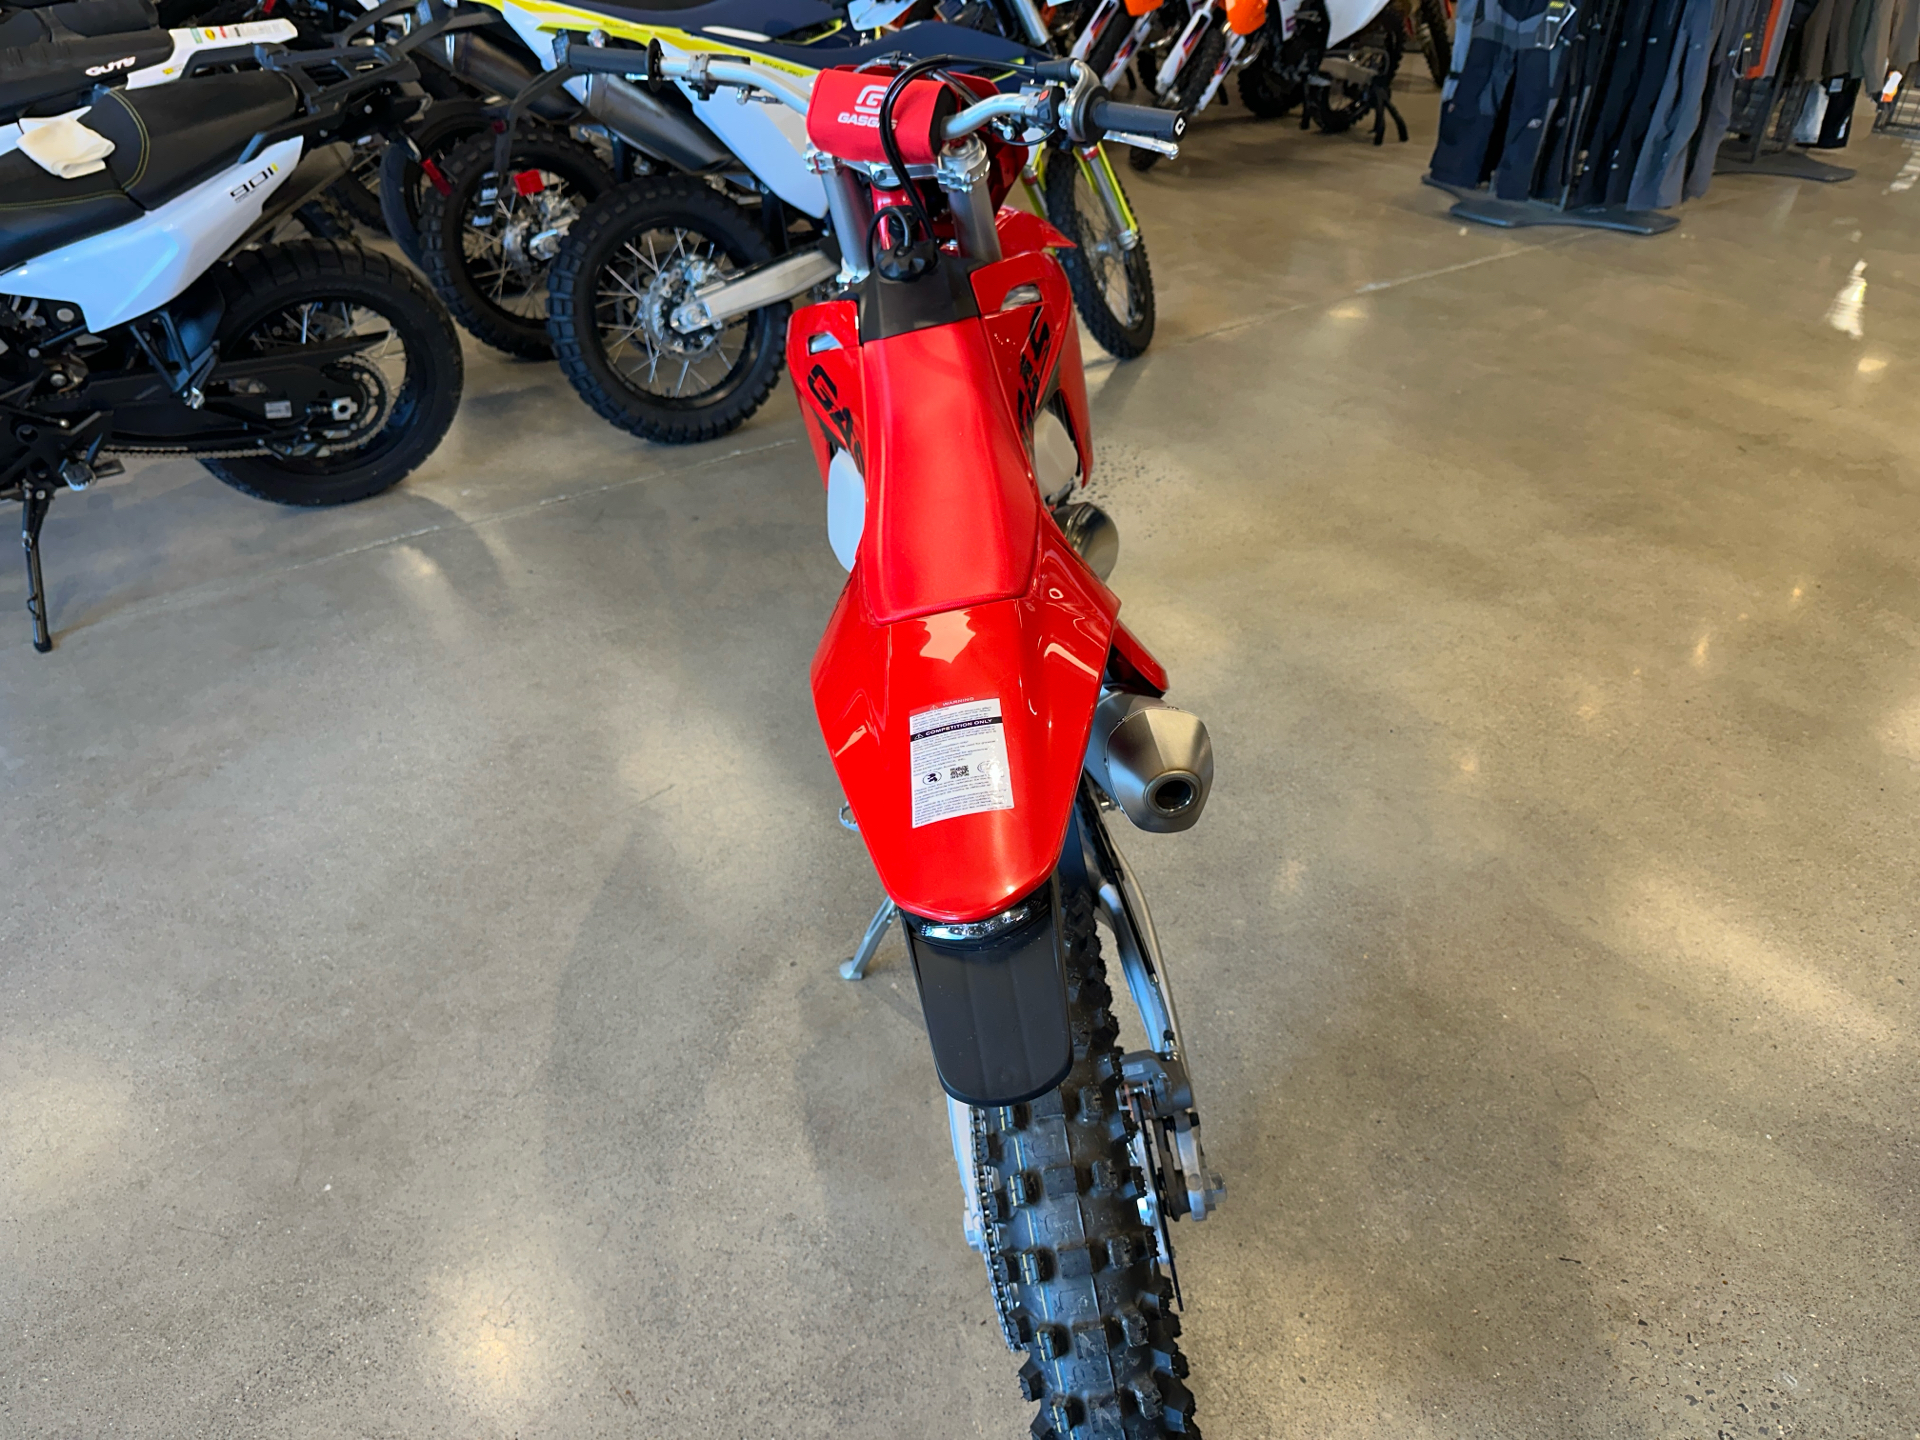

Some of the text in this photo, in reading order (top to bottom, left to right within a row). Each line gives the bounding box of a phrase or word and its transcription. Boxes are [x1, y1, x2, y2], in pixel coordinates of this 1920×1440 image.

[837, 111, 898, 130] GASGS
[230, 166, 274, 201] 901
[942, 697, 974, 706] WARNING
[925, 722, 972, 736] COMPETITION
